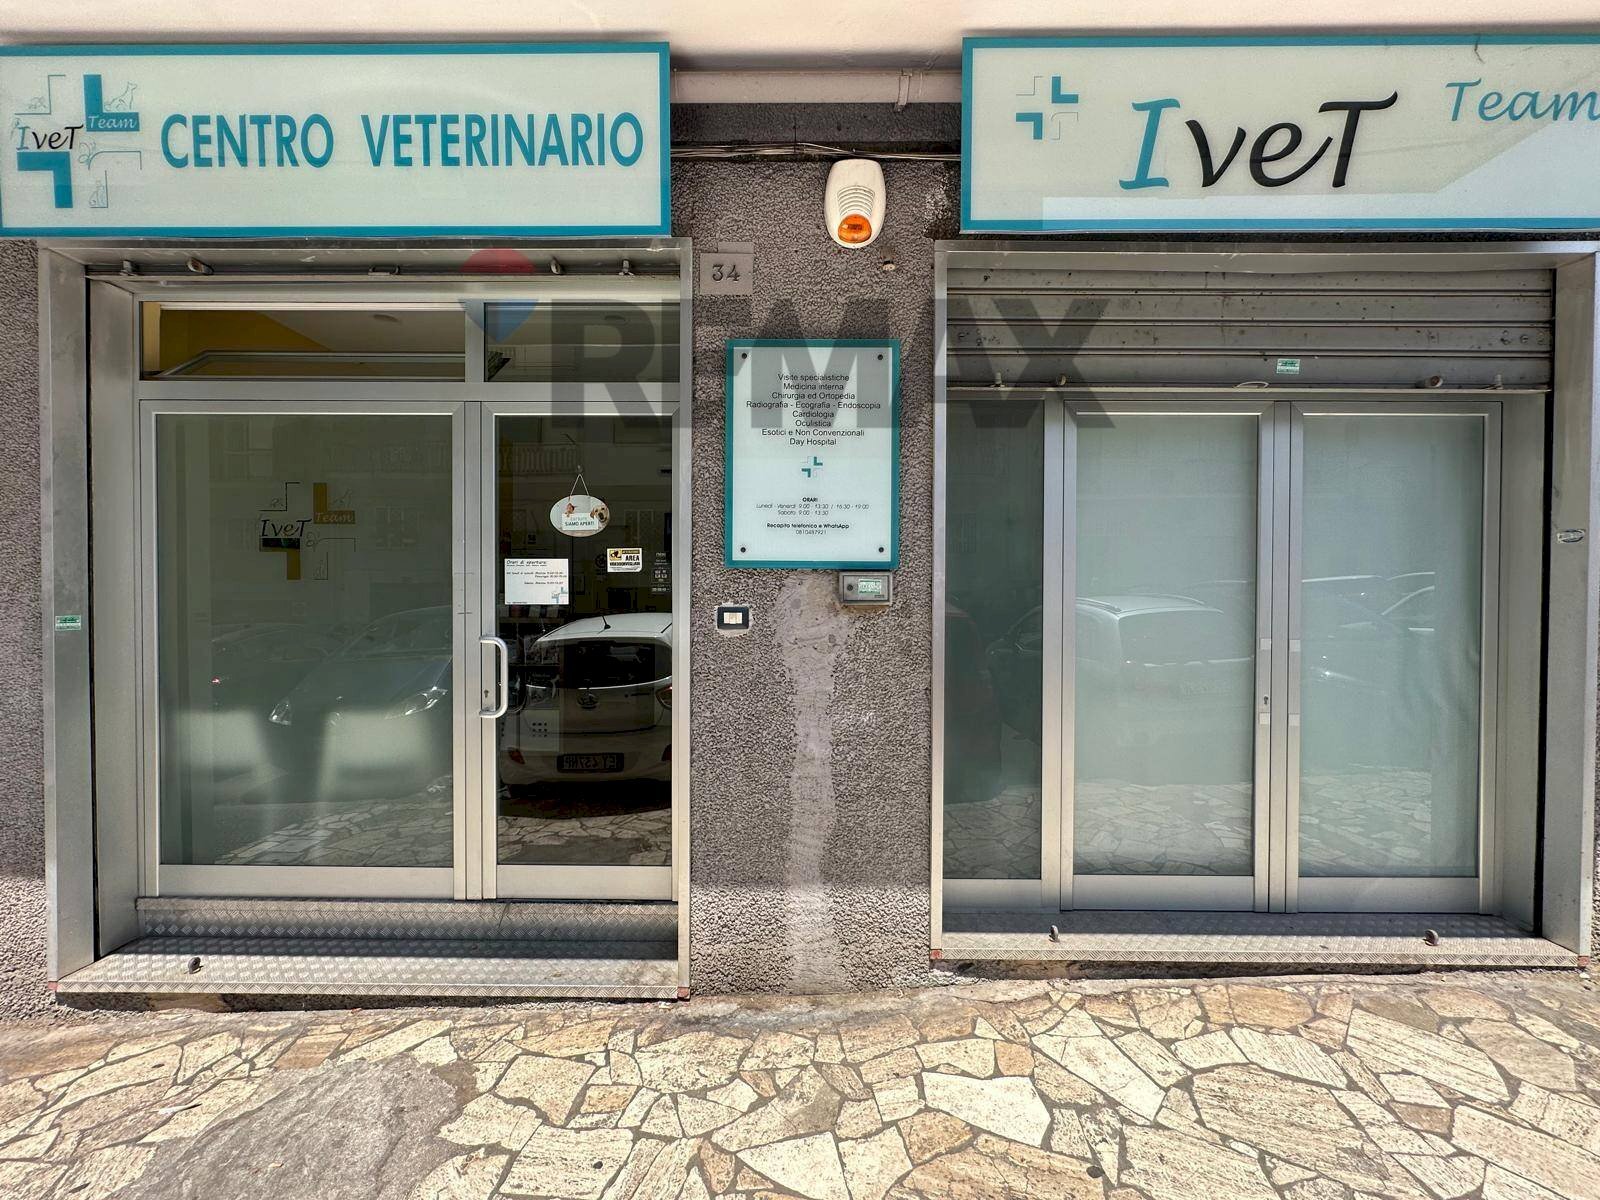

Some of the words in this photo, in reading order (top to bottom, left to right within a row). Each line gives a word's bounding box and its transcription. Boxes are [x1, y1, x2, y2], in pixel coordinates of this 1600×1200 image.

[16, 124, 84, 150] IveT
[88, 115, 137, 129] Team
[1118, 90, 1398, 190] IveT
[1445, 78, 1600, 121] Team
[160, 112, 335, 169] CENTRO
[361, 111, 644, 169] VETERINARIO
[712, 263, 741, 282] 34
[800, 374, 850, 383] specialistiche
[783, 383, 817, 391] Medicina
[818, 383, 844, 391] interna
[771, 392, 806, 401] Chirurgia
[807, 392, 817, 400] ed
[819, 392, 856, 401] Ortopedia
[746, 401, 789, 409] Radiografia
[795, 401, 831, 409] Ecografia
[837, 402, 881, 410] Endoscopia
[792, 410, 835, 419] Cardiologia
[795, 419, 832, 427] Oculistica
[762, 429, 786, 437] Esotici
[795, 429, 811, 437] Non
[812, 429, 865, 437] Convenzionali
[789, 438, 805, 447] Day
[806, 438, 837, 447] Hospital
[260, 518, 313, 538] IveT
[823, 523, 850, 531] WhatsApp
